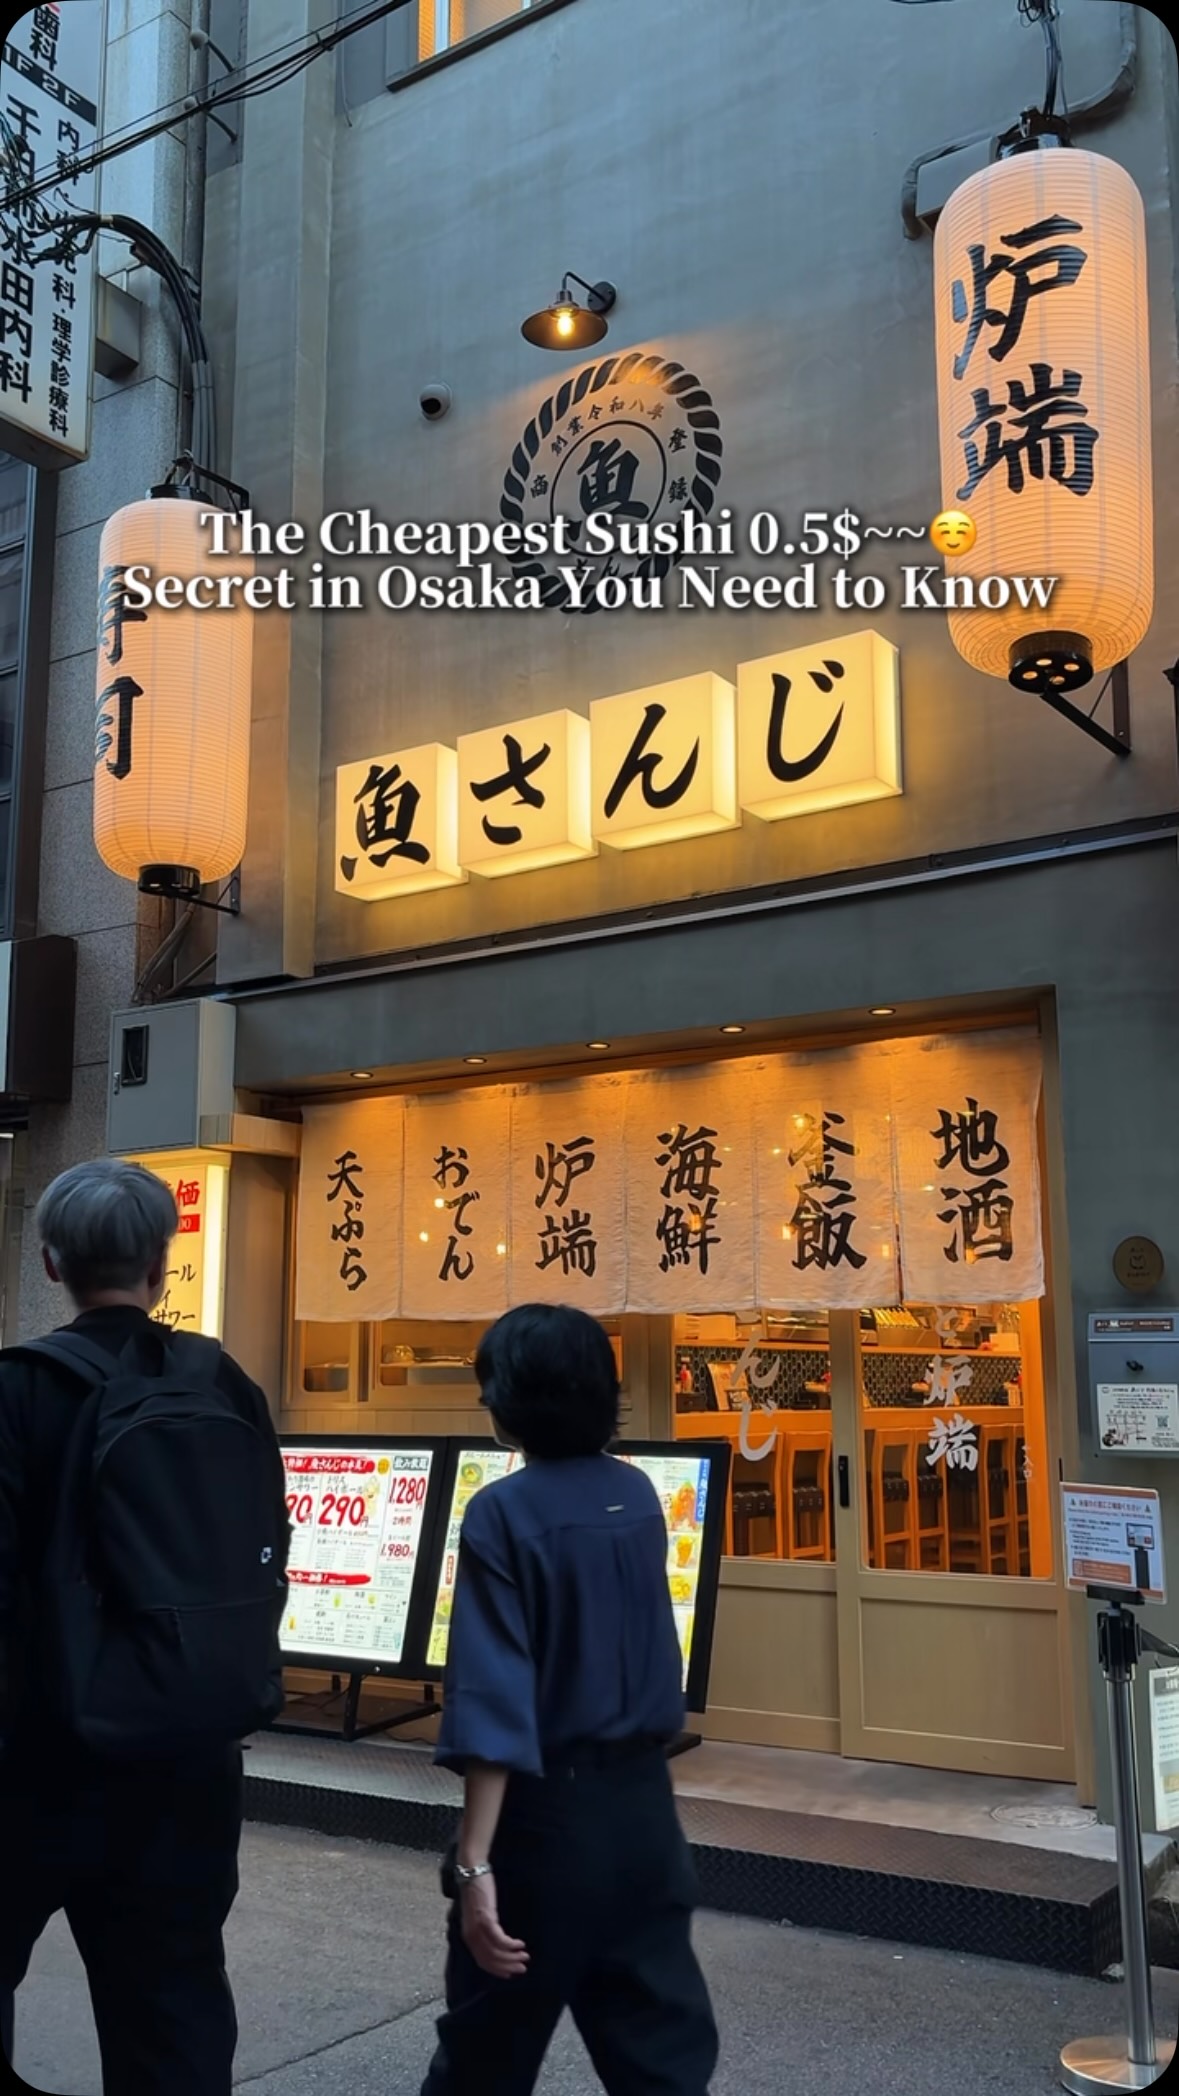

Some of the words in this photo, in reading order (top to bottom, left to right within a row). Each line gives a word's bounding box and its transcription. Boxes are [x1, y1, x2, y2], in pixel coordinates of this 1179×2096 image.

[5, 45, 34, 71] 1F
[41, 73, 81, 106] 2F
[29, 6, 60, 72] 歯科
[951, 214, 1099, 501] 炉端
[340, 659, 845, 882] 魚さんじ
[167, 1178, 200, 1208] 価
[327, 1150, 367, 1291] 天ぷら
[432, 1146, 480, 1281] おでん
[535, 1136, 597, 1277] 炉端
[654, 1123, 723, 1275] 海鮮
[787, 1111, 867, 1272] 釜飯
[930, 1097, 1014, 1265] 地酒
[731, 1311, 780, 1462] んじ
[922, 1307, 979, 1472] と炉端
